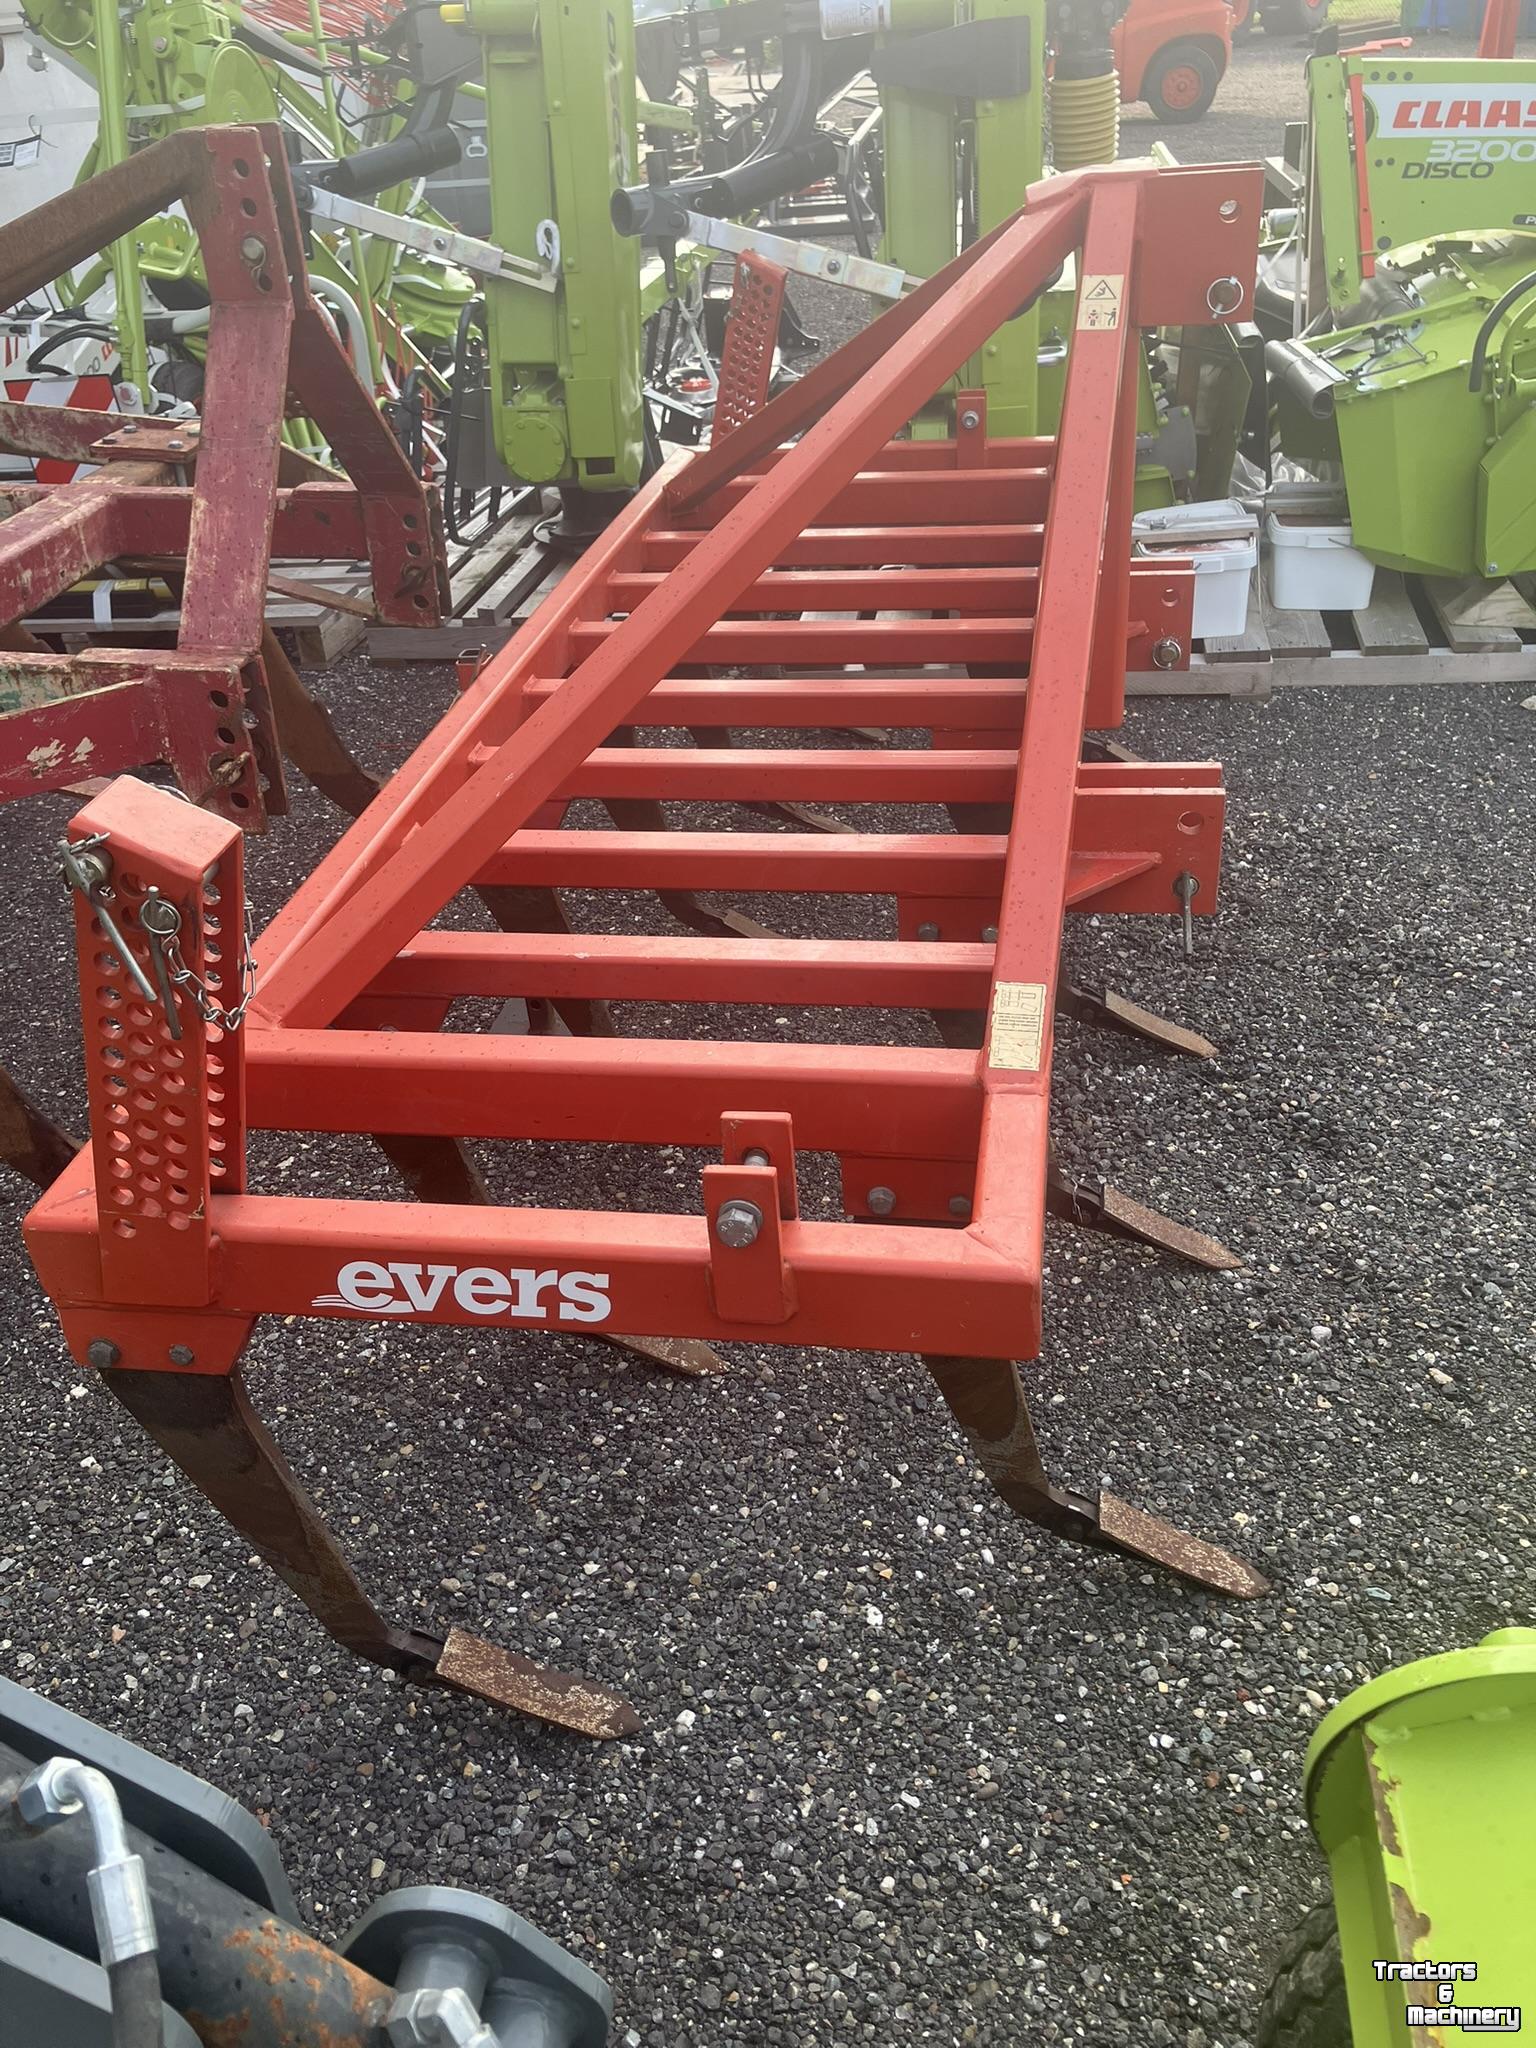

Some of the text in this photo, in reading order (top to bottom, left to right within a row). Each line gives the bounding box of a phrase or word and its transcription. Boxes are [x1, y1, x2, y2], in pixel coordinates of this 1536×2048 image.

[1426, 139, 1536, 163] 3200
[1401, 162, 1495, 180] DISCO
[336, 1260, 612, 1323] evers
